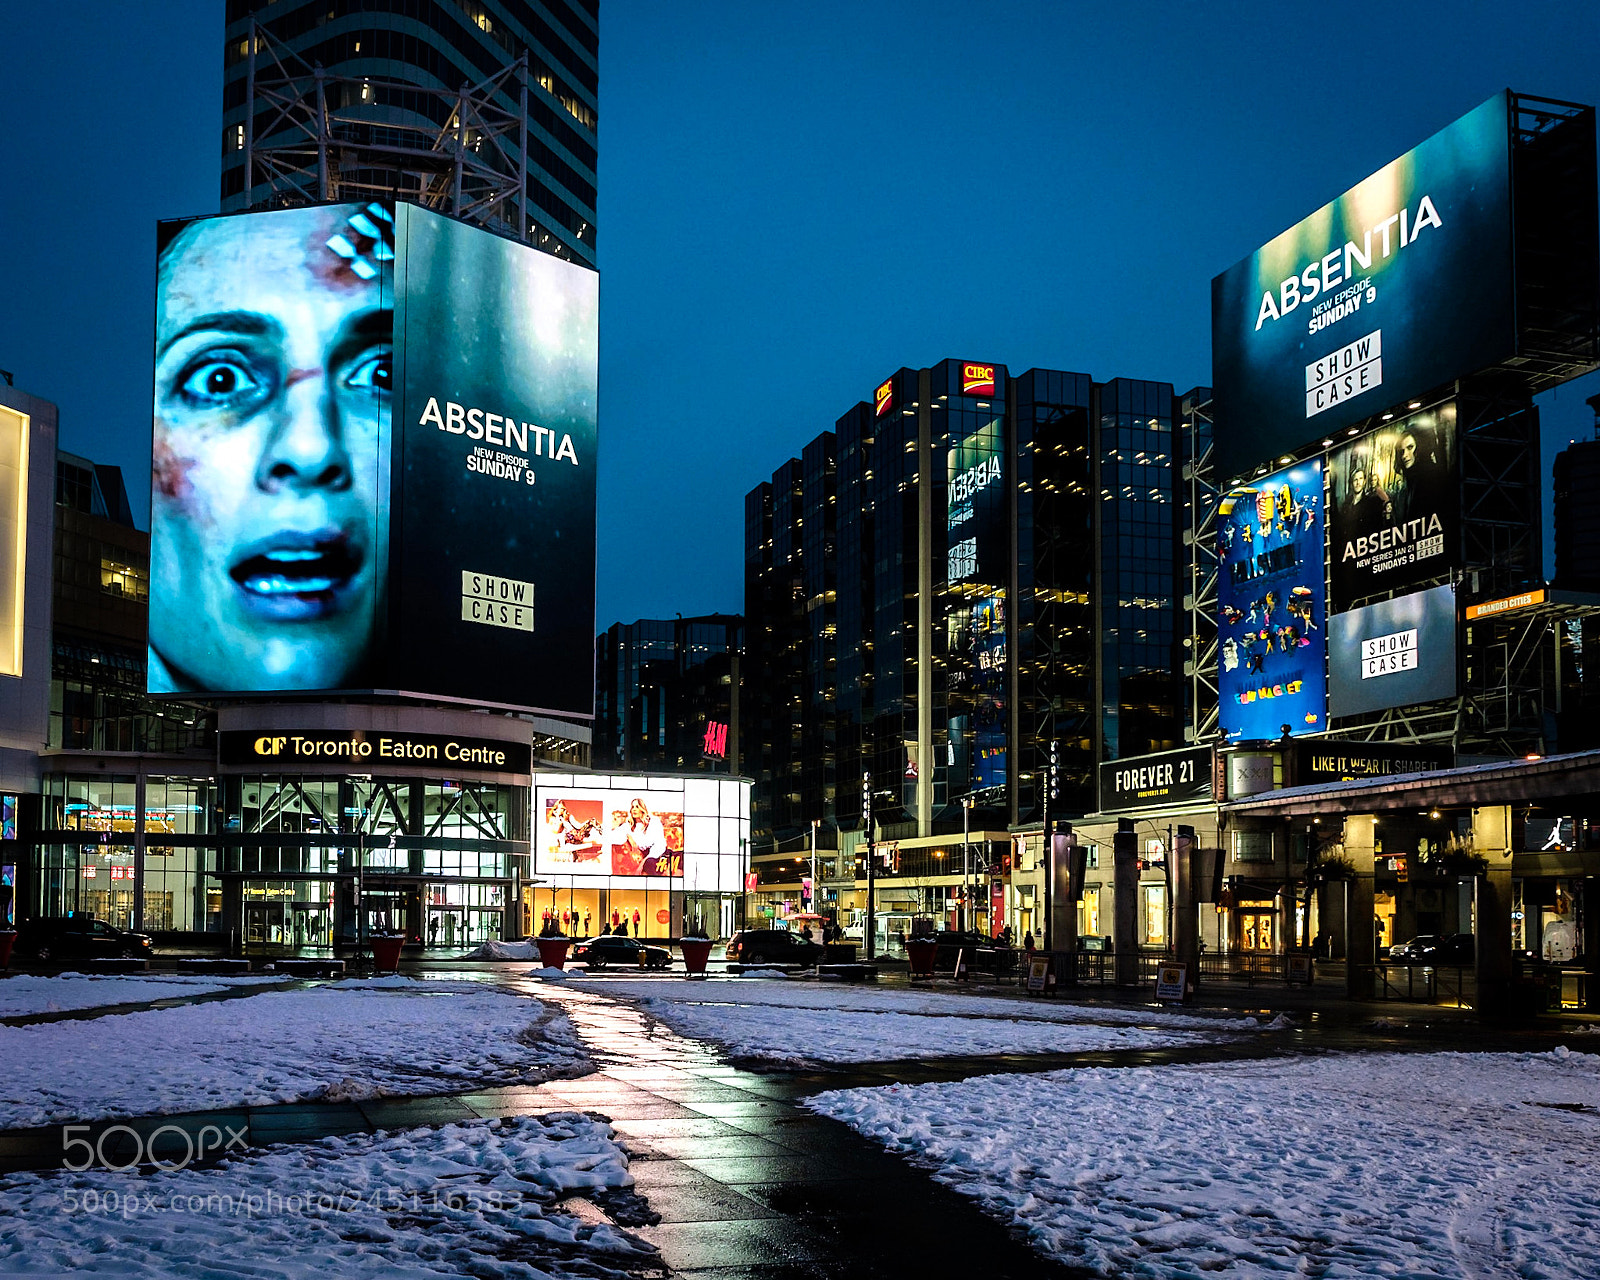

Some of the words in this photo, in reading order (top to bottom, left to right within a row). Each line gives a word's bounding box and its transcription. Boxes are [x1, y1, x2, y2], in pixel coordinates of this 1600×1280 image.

[1255, 195, 1442, 331] ABSENTIA
[1312, 298, 1332, 317] NEW
[1334, 276, 1372, 304] EPISODE
[1308, 294, 1362, 335] SUNDAY
[1366, 286, 1376, 304] 9
[964, 365, 993, 380] CIBC
[1315, 338, 1371, 382] SHOW
[876, 380, 892, 401] CIBC
[1315, 367, 1369, 409] CASE
[419, 397, 579, 465] ABSENTIA
[466, 454, 521, 482] SUNDAY
[526, 470, 536, 485] 9
[474, 446, 494, 460] NEW
[495, 451, 530, 469] EPISODE
[1341, 513, 1443, 562] ABSENTIA
[1419, 535, 1441, 549] SHOW
[1356, 558, 1371, 568] NEW
[1371, 551, 1394, 565] SERIES
[1394, 547, 1406, 558] JAN
[1407, 544, 1415, 554] 21
[1372, 555, 1408, 574] SUNDAYS
[1409, 553, 1415, 563] 9
[472, 576, 525, 602] SHOW
[472, 601, 523, 626] CASE
[1477, 600, 1508, 615] BRANDED
[1509, 594, 1532, 609] CITIES
[1369, 633, 1410, 656] SHOW
[1369, 653, 1408, 674] CASE
[254, 736, 287, 755] CF
[290, 736, 372, 756] Toronto
[379, 738, 438, 760] Eaton
[444, 742, 506, 765] Centre
[1115, 763, 1173, 792] FOREVER
[1179, 759, 1194, 783] 21
[1312, 755, 1335, 772] LIKE
[1350, 758, 1379, 774] WEAR
[1394, 760, 1427, 774] SHARE
